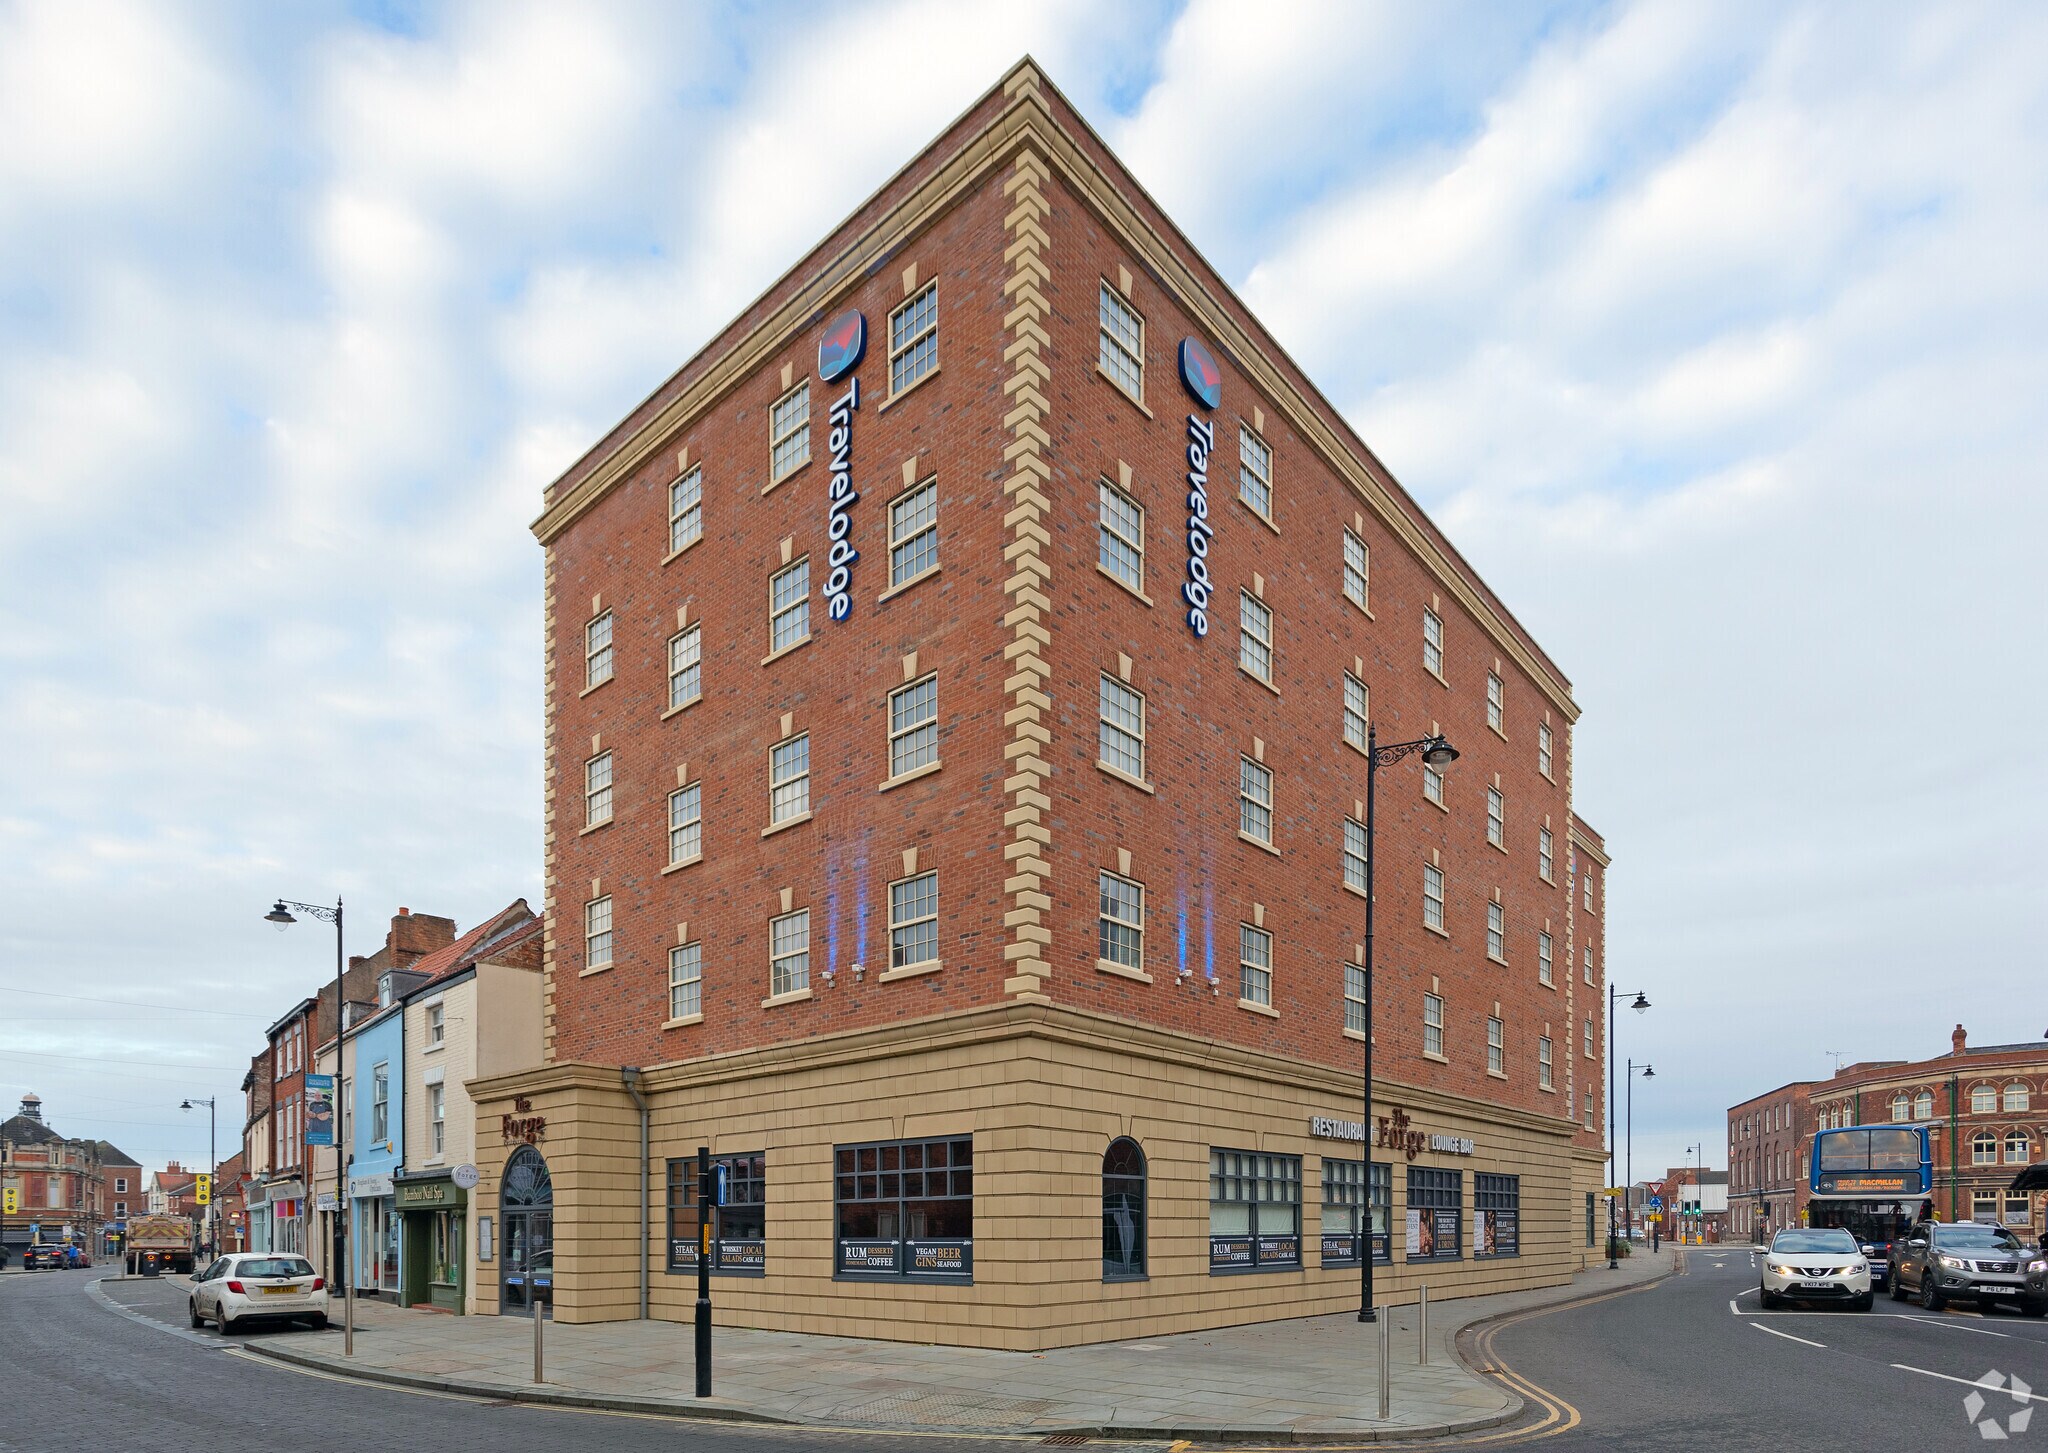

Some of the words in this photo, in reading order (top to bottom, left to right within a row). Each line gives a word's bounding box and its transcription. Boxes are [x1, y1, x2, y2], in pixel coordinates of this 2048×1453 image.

[823, 377, 859, 621] Travelodge
[1181, 413, 1213, 638] Travelodge
[514, 1095, 532, 1112] The
[1392, 1108, 1410, 1128] The
[502, 1113, 547, 1145] Forge
[1376, 1116, 1426, 1161] Forge
[1432, 1134, 1460, 1154] LOUNGE
[1460, 1138, 1473, 1154] BAR
[404, 1188, 422, 1201] Bamboo
[423, 1186, 433, 1200] Nail
[433, 1185, 443, 1202] Spa
[675, 1245, 694, 1254] STEAK
[742, 1246, 763, 1255] LOCAL
[1213, 1243, 1231, 1254] RUM
[1279, 1242, 1296, 1250] LOCAL
[1322, 1241, 1339, 1249] STEAK
[846, 1247, 867, 1258] RUM
[868, 1247, 893, 1255] DESSERTS
[916, 1247, 937, 1255] VEGAN
[937, 1247, 961, 1259] BEER
[1231, 1252, 1250, 1261] COFFEE
[1338, 1247, 1352, 1256] WINE
[722, 1255, 742, 1263] SALADS
[867, 1257, 893, 1267] COFFEE
[916, 1257, 937, 1268] GINS
[937, 1260, 961, 1268] SEAFOOD
